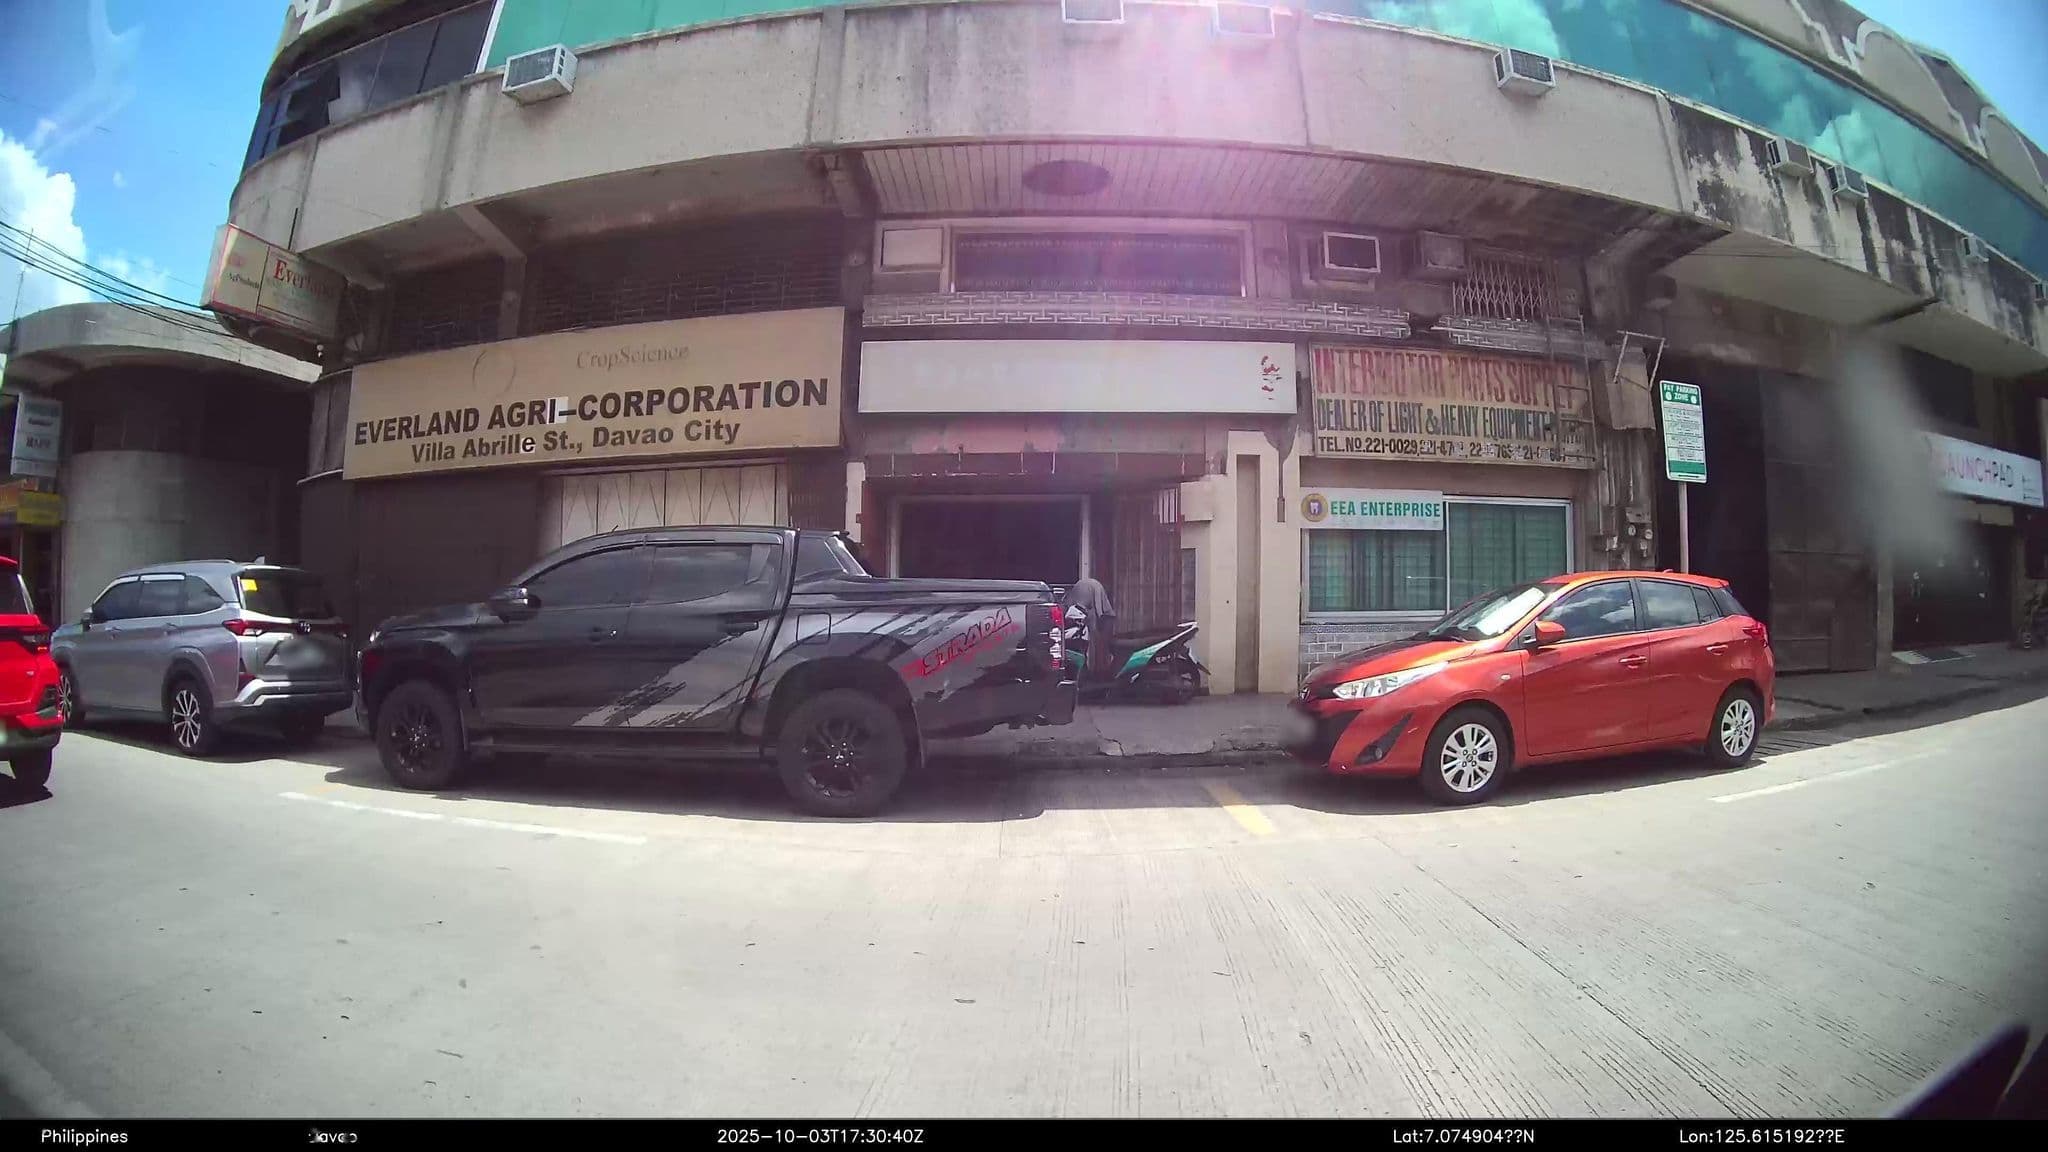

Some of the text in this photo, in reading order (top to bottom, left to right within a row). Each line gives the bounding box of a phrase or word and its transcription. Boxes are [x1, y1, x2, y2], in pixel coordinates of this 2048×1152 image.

[577, 343, 690, 371] CropScience
[1314, 347, 1446, 398] INTERMOTOR
[1448, 354, 1506, 403] PARTS
[354, 407, 480, 445] EVERLAND
[411, 419, 741, 463] Villa Abrille St., Davao City
[1316, 398, 1367, 432] DEALER
[1369, 400, 1384, 433] OF
[1387, 401, 1423, 435] LIGHT
[1426, 408, 1440, 435] &
[1441, 404, 1479, 438] HEAVY
[1483, 406, 1547, 442] EQUIPMENT
[1330, 500, 1441, 517] EEA ENTERPRISE
[922, 607, 1012, 676] STRADA
